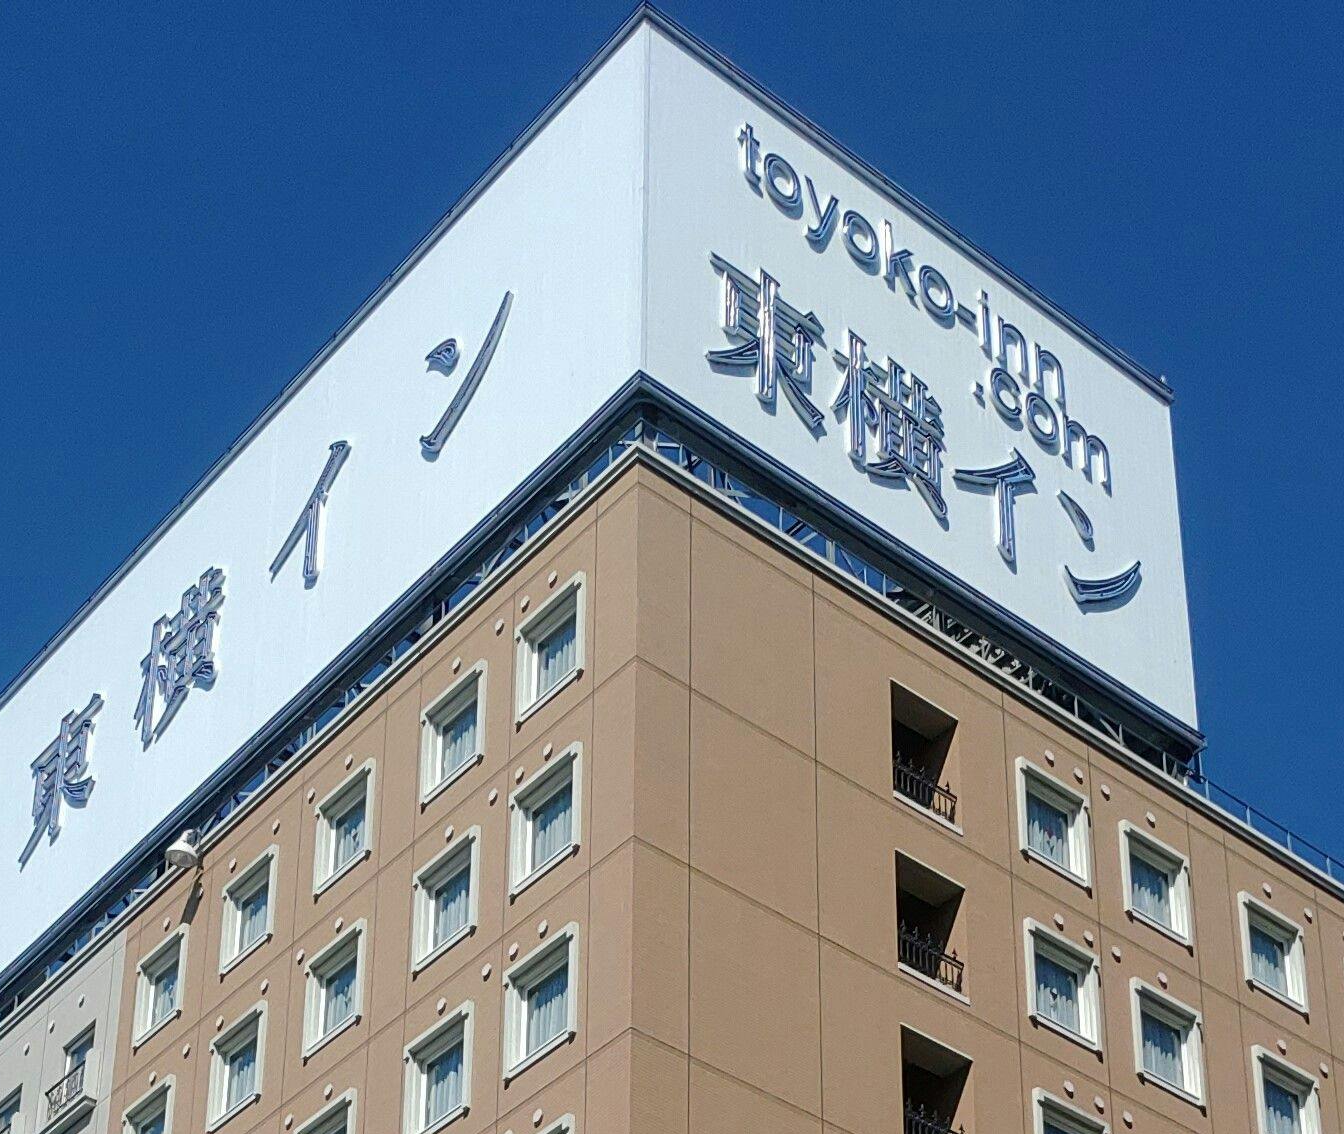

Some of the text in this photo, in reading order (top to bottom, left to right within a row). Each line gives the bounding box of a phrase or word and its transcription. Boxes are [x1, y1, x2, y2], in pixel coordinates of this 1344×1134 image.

[736, 122, 1066, 399] toyoko-inn
[19, 291, 513, 870] 東横イン
[707, 252, 1142, 604] 東横イン
[971, 366, 1111, 492] .com
